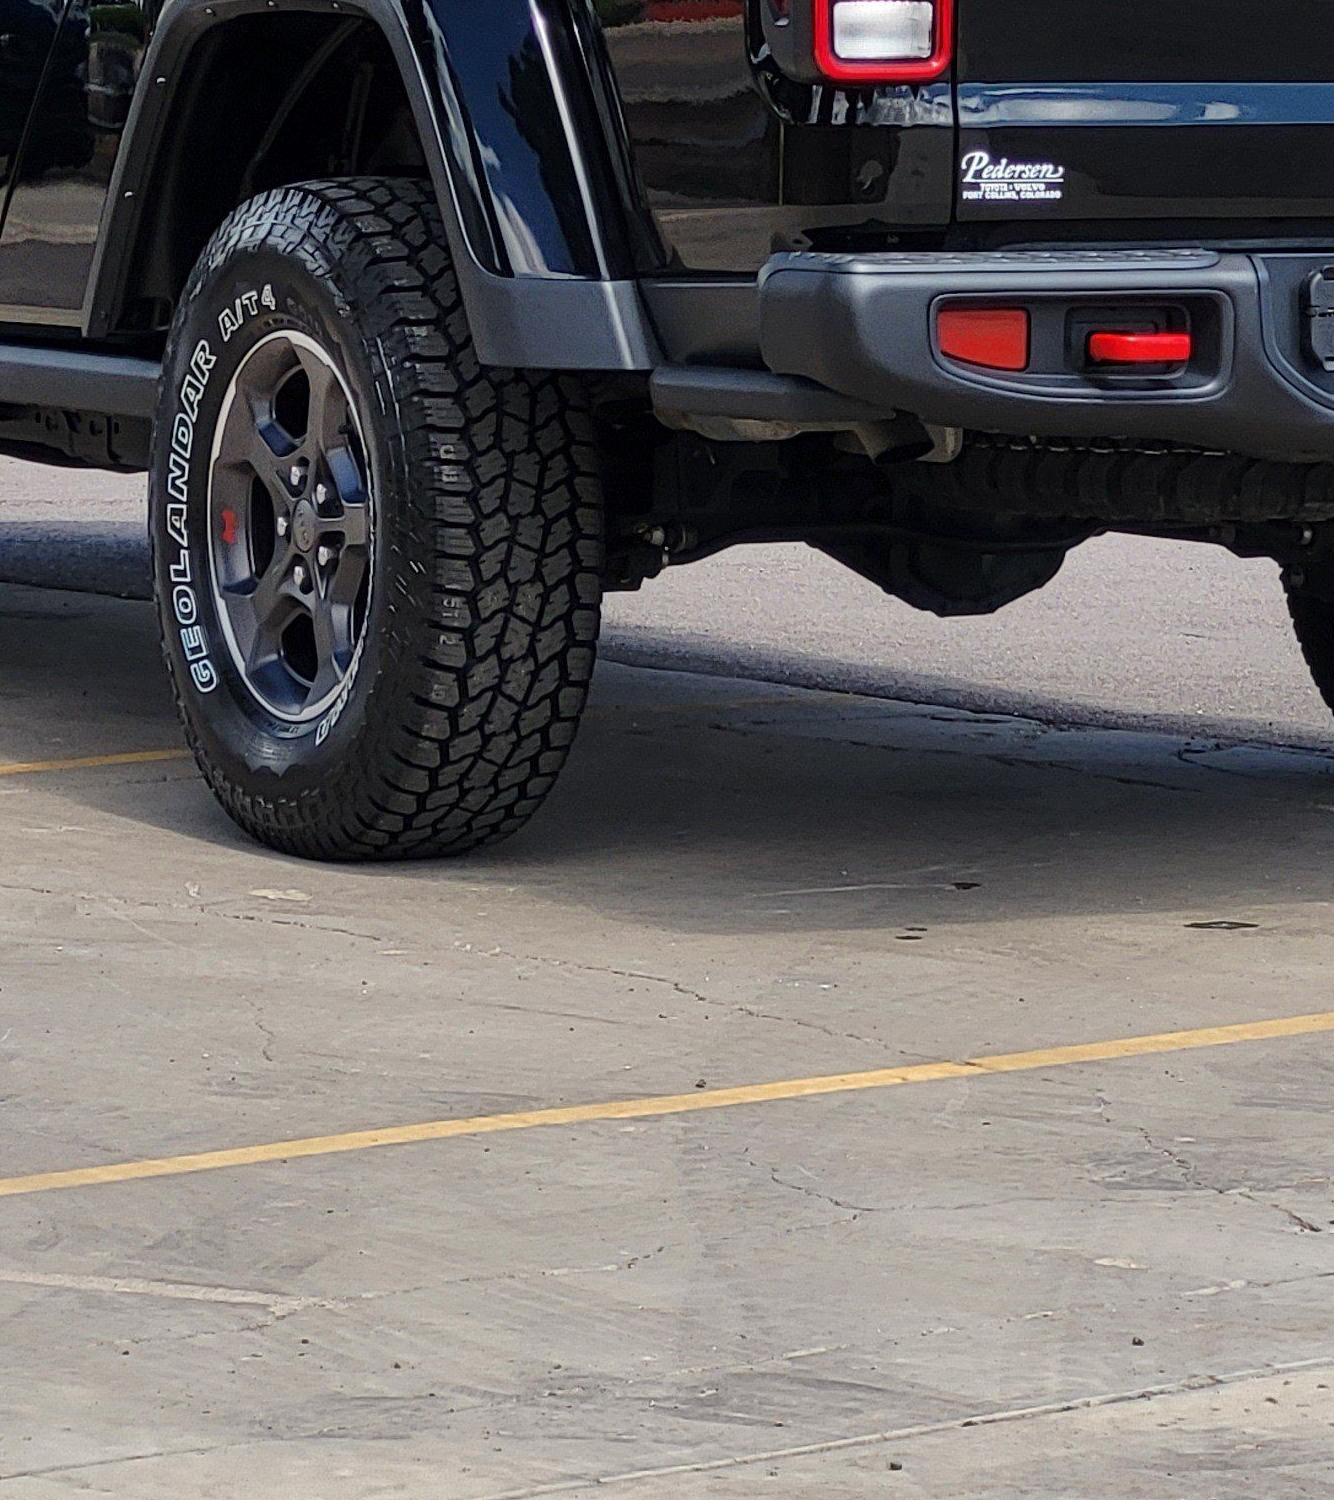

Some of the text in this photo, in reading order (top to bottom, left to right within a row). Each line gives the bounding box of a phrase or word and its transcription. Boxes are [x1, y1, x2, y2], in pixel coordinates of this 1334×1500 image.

[961, 150, 1065, 182] Pedersen
[218, 283, 277, 342] A/T4
[167, 339, 218, 694] GEOLANDAR
